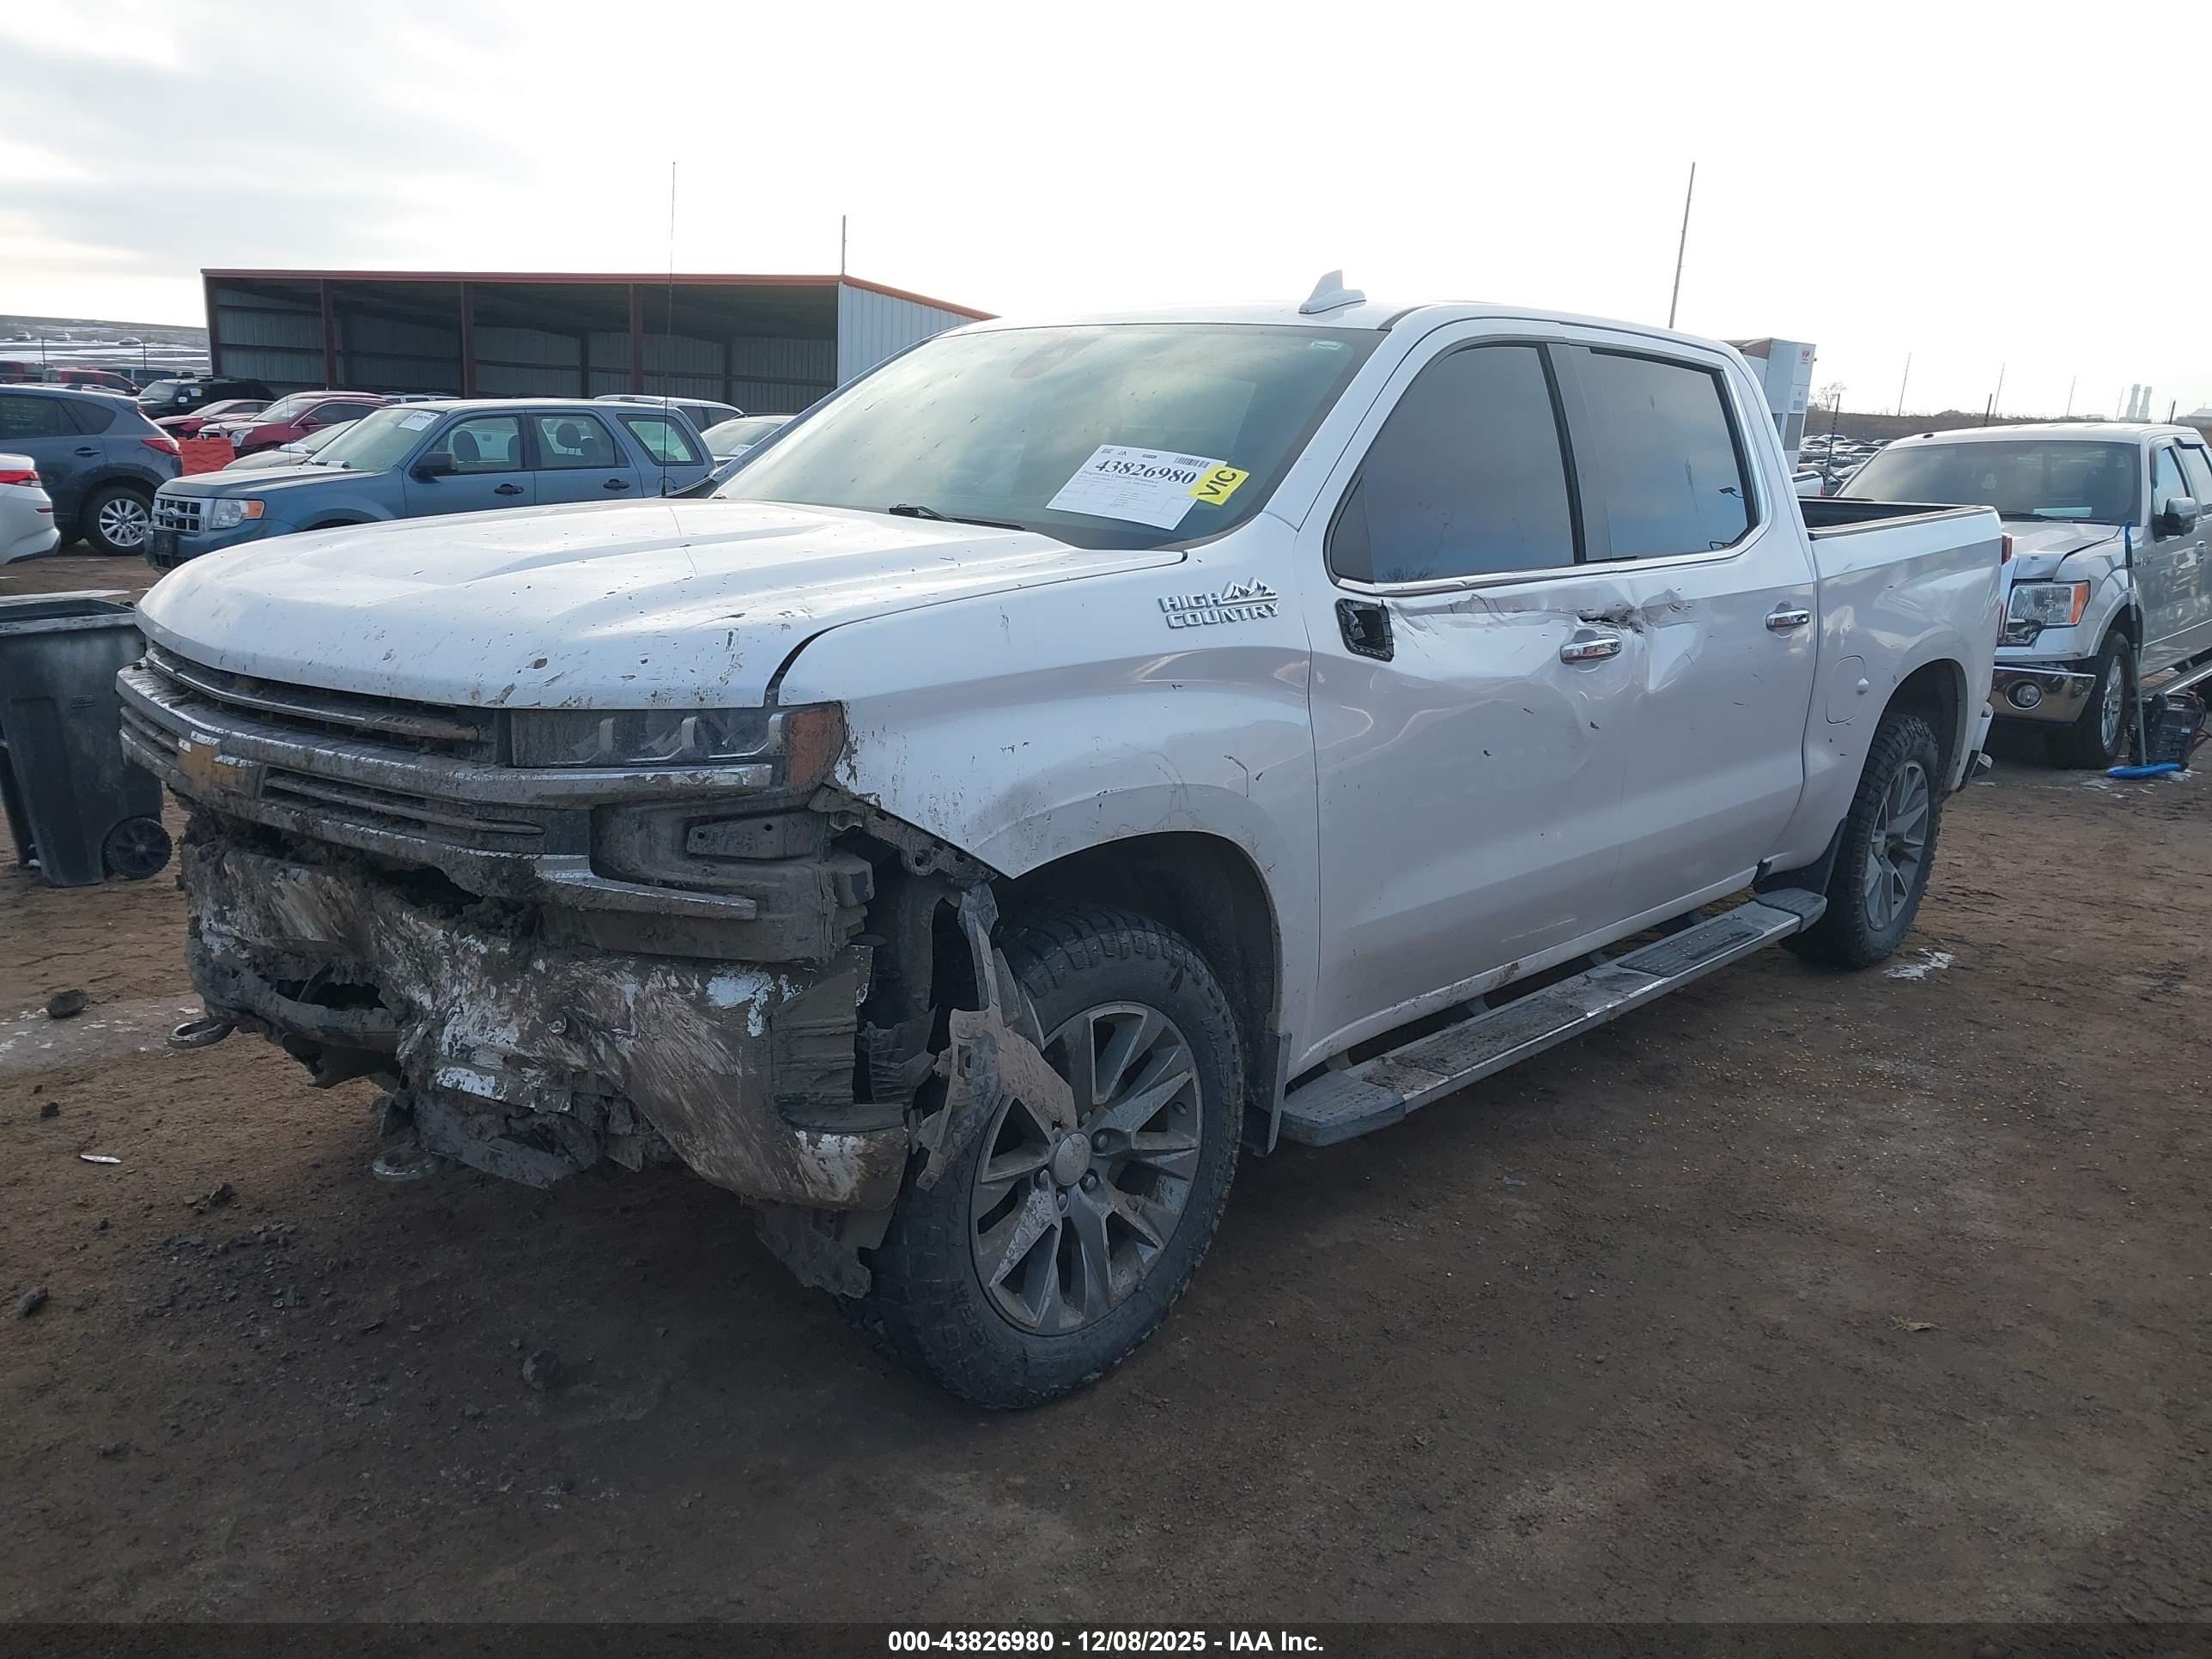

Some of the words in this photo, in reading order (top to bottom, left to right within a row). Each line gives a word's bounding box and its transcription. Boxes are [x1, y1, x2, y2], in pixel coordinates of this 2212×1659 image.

[1095, 459, 1197, 484] 43826980
[1197, 470, 1237, 495] VIC
[1158, 592, 1223, 612] HIGH
[1166, 603, 1279, 629] COUNTRY
